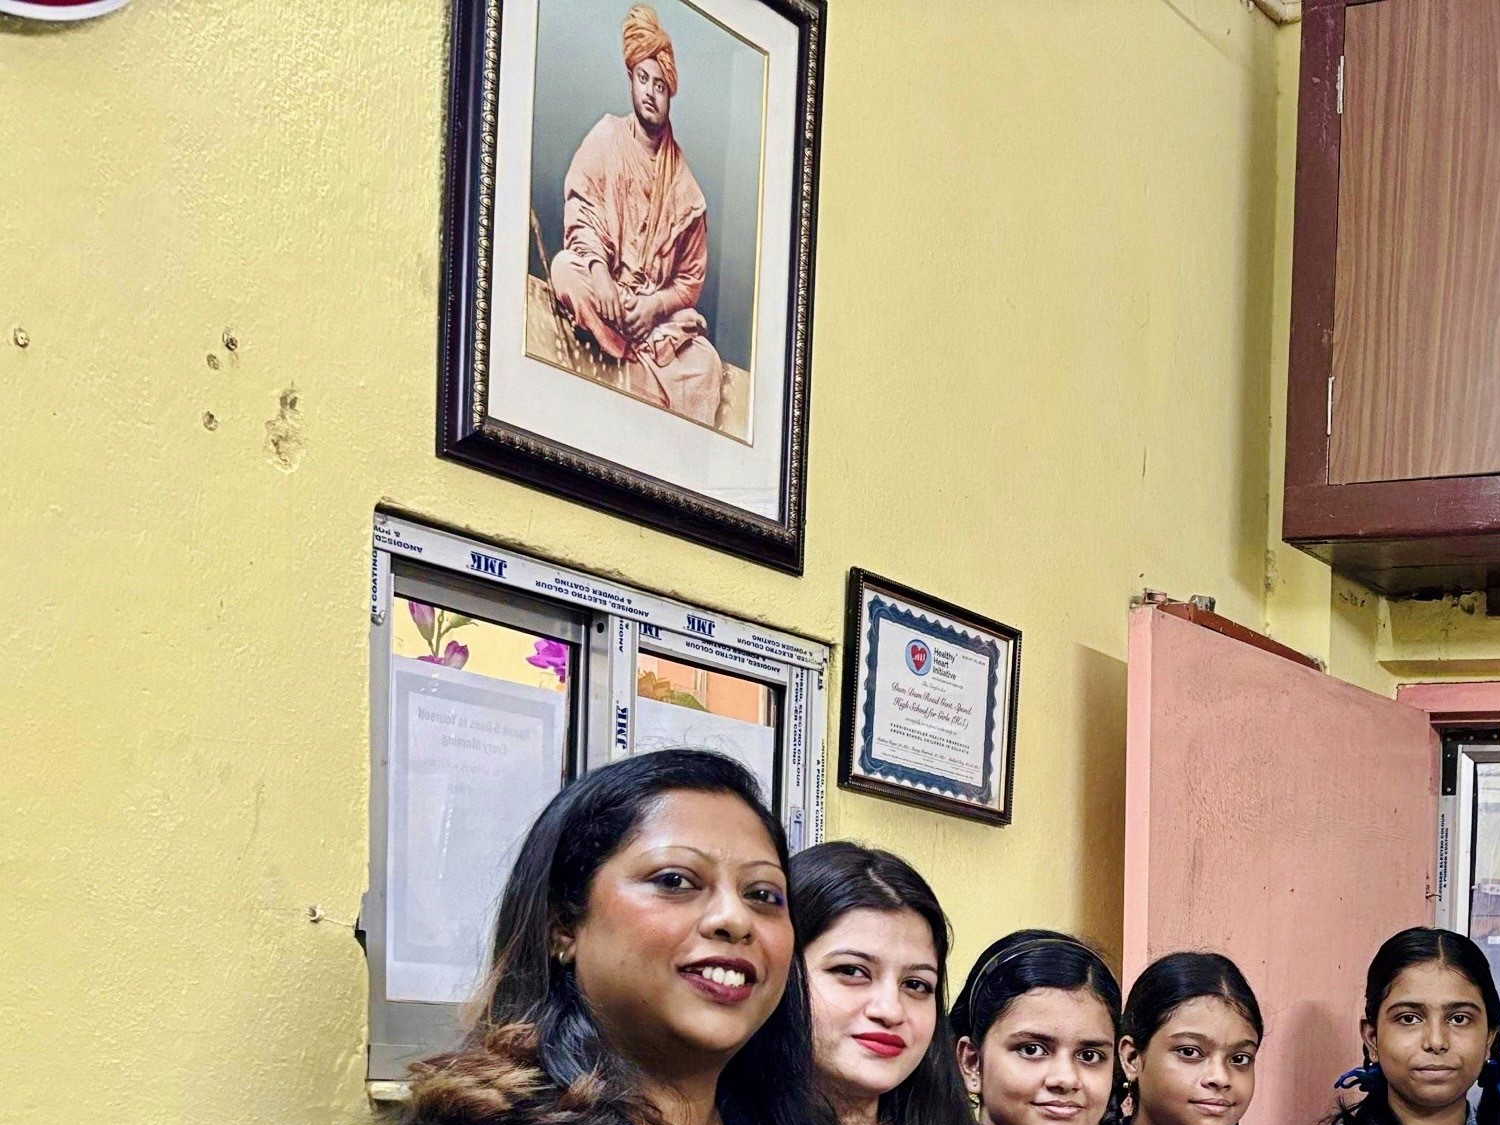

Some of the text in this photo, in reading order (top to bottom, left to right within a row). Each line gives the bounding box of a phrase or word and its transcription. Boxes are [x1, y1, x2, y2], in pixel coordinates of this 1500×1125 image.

[470, 551, 508, 580] JMK
[554, 577, 590, 593] COATING
[535, 580, 649, 617] ANODISED, ELECTRO COLOUR
[592, 589, 625, 603] POWDER
[687, 614, 716, 638] JMK
[737, 638, 794, 659] ELECTRO COLOUR
[751, 635, 780, 647] COATING
[685, 641, 781, 673] ANODISED, ELECTRO COLOUR
[933, 657, 949, 669] Heart
[934, 647, 956, 663] Healthy
[932, 667, 957, 680] Initiative
[615, 705, 628, 749] JMK
